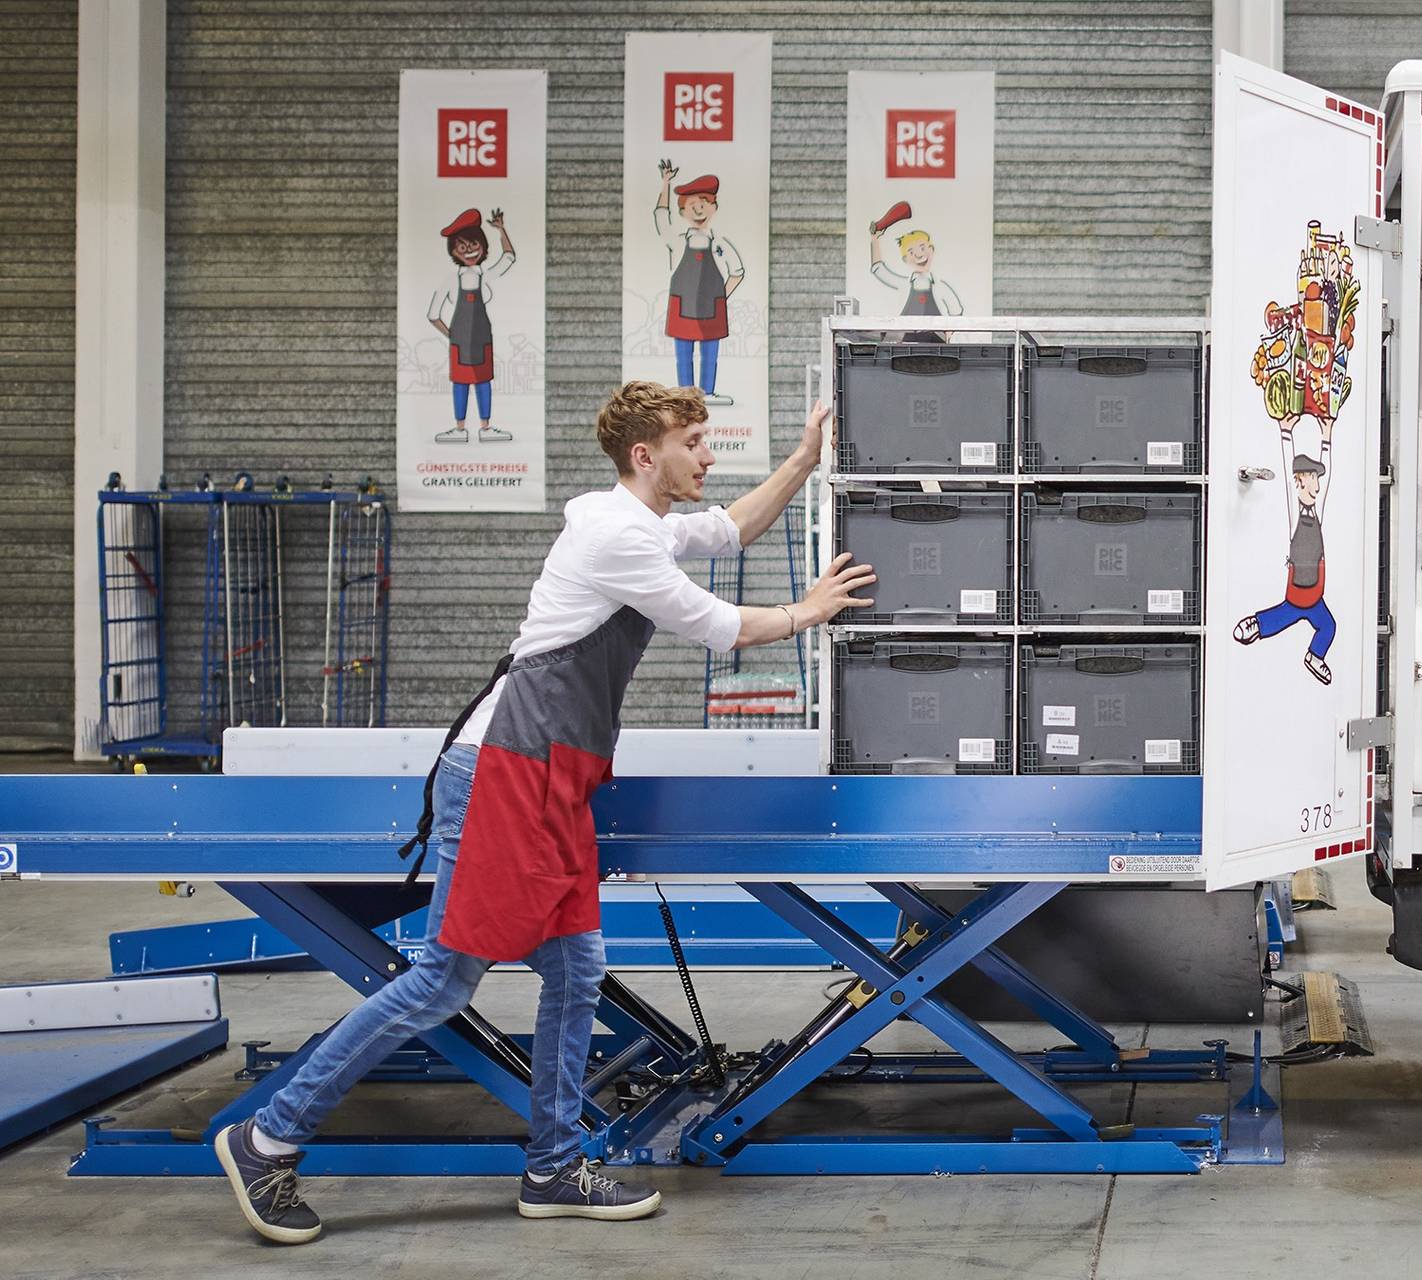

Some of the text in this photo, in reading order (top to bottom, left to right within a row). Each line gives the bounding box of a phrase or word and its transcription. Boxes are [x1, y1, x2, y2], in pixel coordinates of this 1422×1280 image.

[714, 427, 753, 437] PREISE
[490, 463, 528, 472] PREISE
[422, 477, 522, 487] GRATIS GELIEFERT
[1300, 803, 1332, 833] 378
